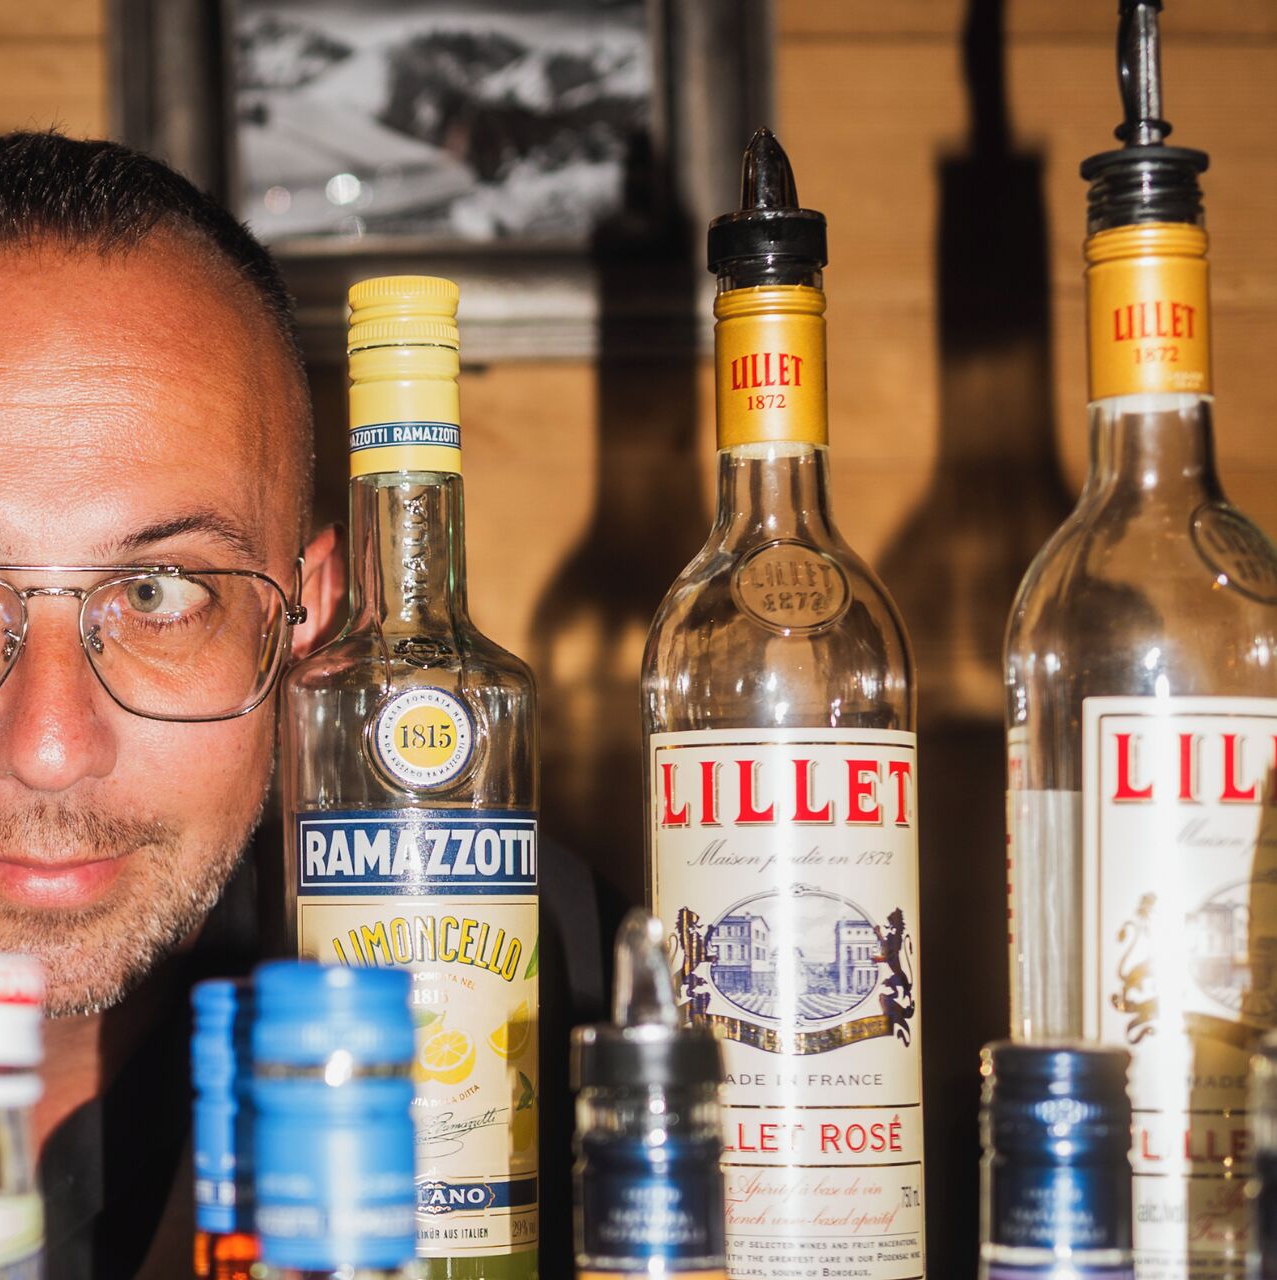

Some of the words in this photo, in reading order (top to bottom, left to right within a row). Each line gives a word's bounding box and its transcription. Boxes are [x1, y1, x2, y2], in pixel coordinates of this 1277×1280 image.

[1112, 300, 1196, 342] LILLET
[1131, 346, 1180, 364] 1872
[730, 352, 804, 391] LILLET
[746, 394, 787, 411] 1872
[392, 426, 460, 444] RAMAZZOTTI
[399, 723, 452, 749] 1815
[660, 758, 913, 828] LILLET
[305, 828, 536, 877] RAMAZZOTTI
[686, 838, 762, 867] Maison
[828, 856, 850, 867] en
[854, 850, 895, 868] 1872
[332, 915, 523, 983] LIMONCELLO
[807, 1073, 883, 1086] FRANCE
[458, 1083, 481, 1102] DITTA
[819, 1113, 903, 1154] ROSÉ
[443, 1228, 459, 1240] AUS
[460, 1226, 489, 1240] ITALIEN
[831, 1241, 849, 1250] AND
[746, 1254, 764, 1263] THE
[818, 1255, 843, 1264] CARE
[844, 1255, 854, 1263] IN
